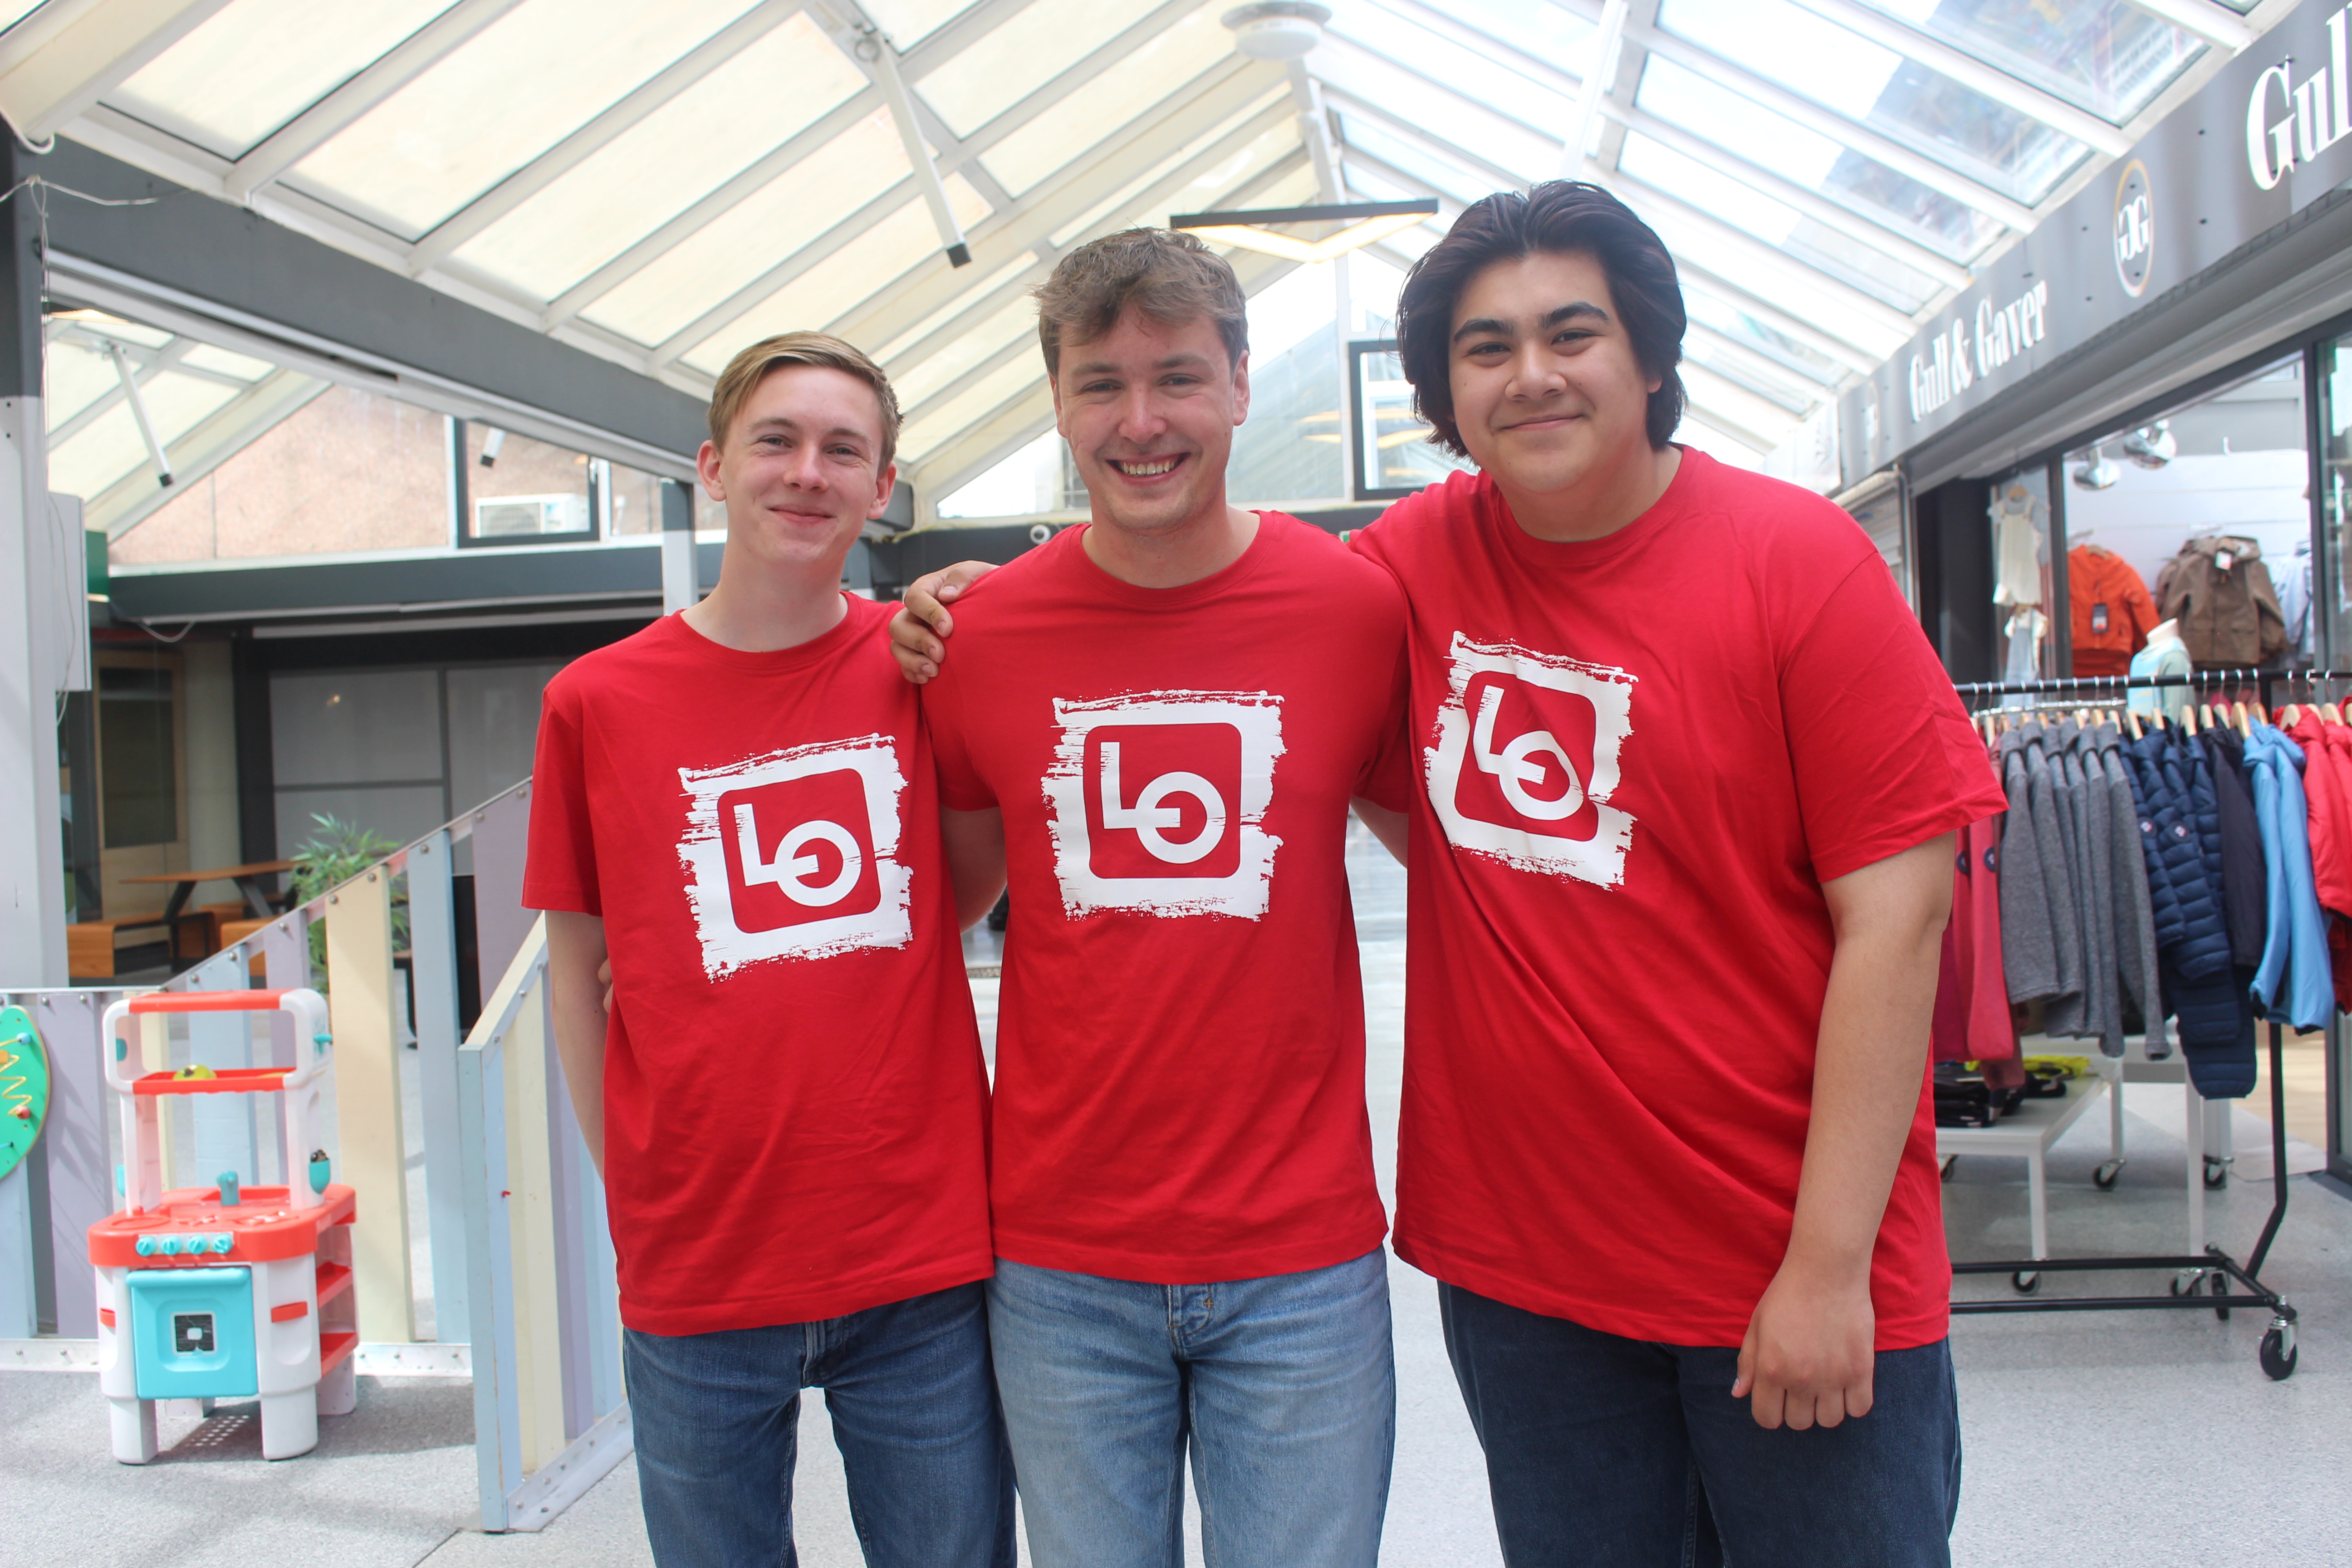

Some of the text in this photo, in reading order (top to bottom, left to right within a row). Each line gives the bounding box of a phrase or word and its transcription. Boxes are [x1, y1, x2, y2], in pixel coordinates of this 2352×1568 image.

[2246, 1, 2352, 191] Gul
[1909, 332, 1951, 423] Gull
[1951, 318, 1974, 396] &
[1975, 279, 2048, 377] Gaver
[1100, 741, 1226, 864] LO
[1473, 685, 1584, 821] LO
[734, 803, 862, 907] LO
